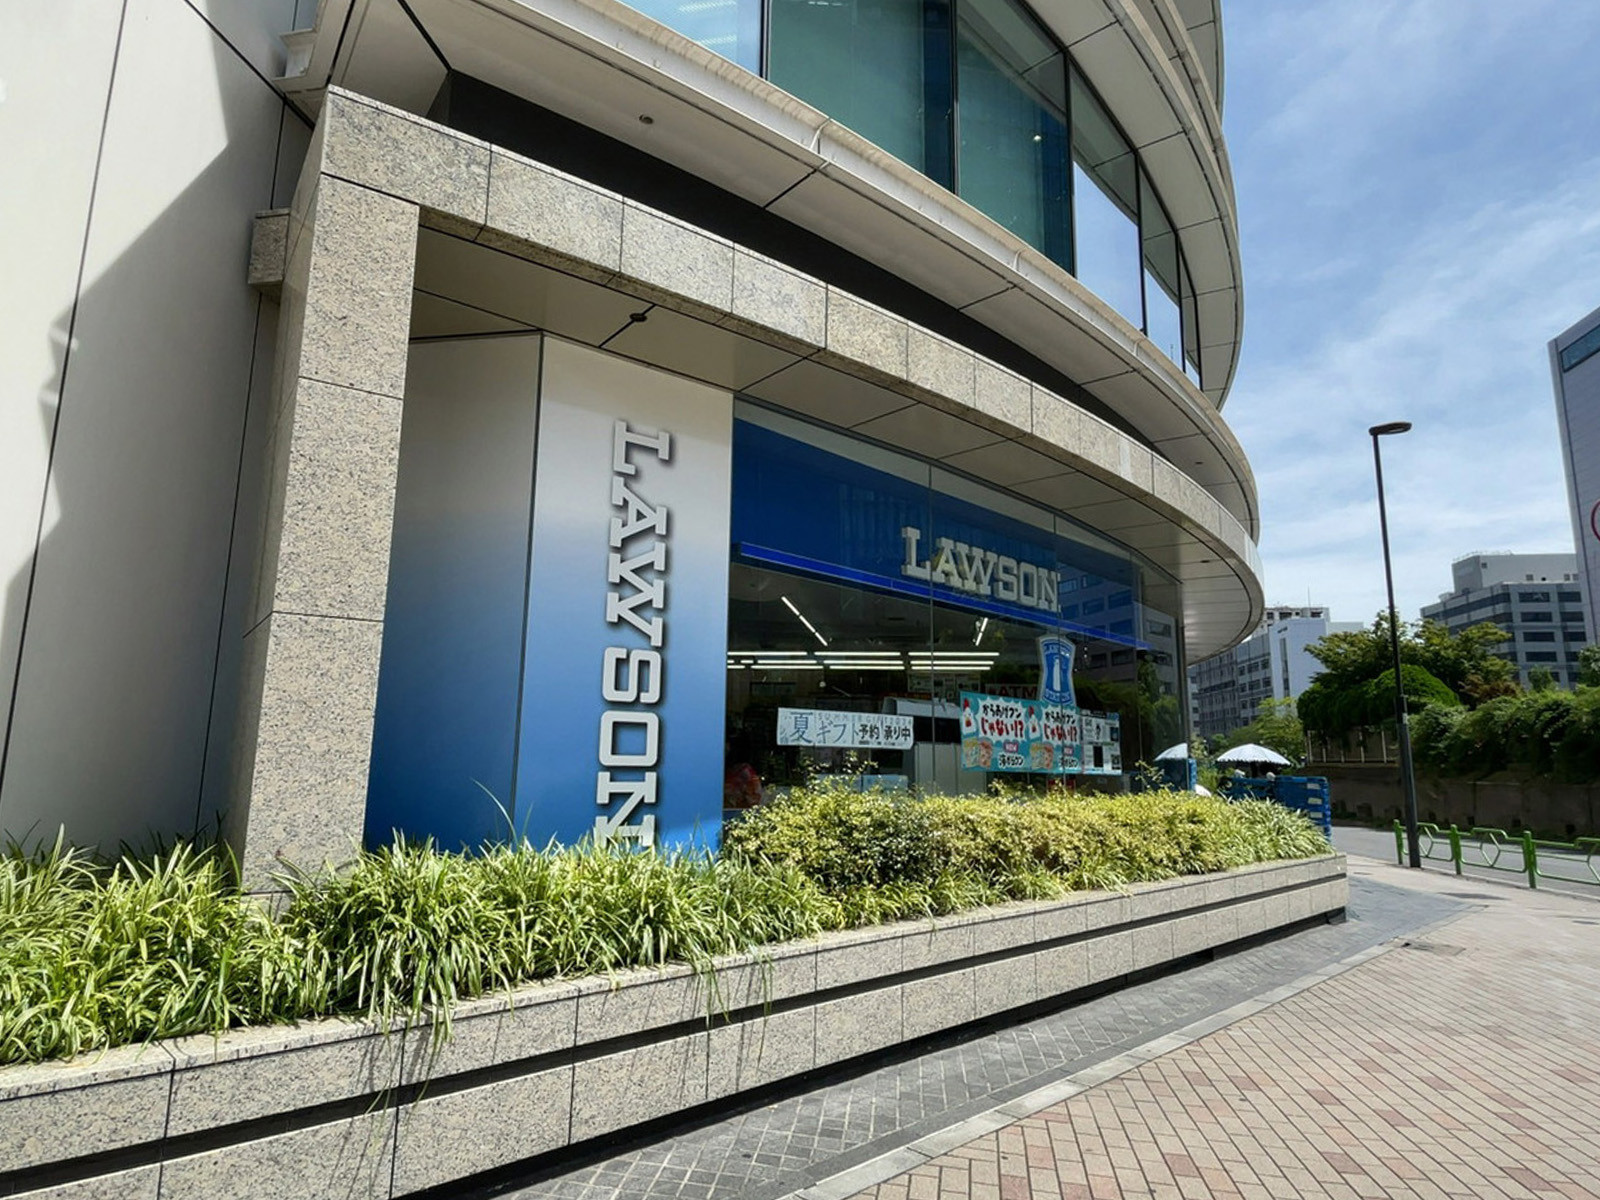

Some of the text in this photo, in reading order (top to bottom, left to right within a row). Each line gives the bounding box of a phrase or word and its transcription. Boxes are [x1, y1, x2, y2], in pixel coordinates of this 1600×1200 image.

[901, 526, 1061, 613] LAWSON
[596, 420, 669, 847] LAWSON
[999, 684, 1037, 700] ATM
[790, 711, 859, 744] 夏ギフト
[982, 703, 1021, 719] からあげクン
